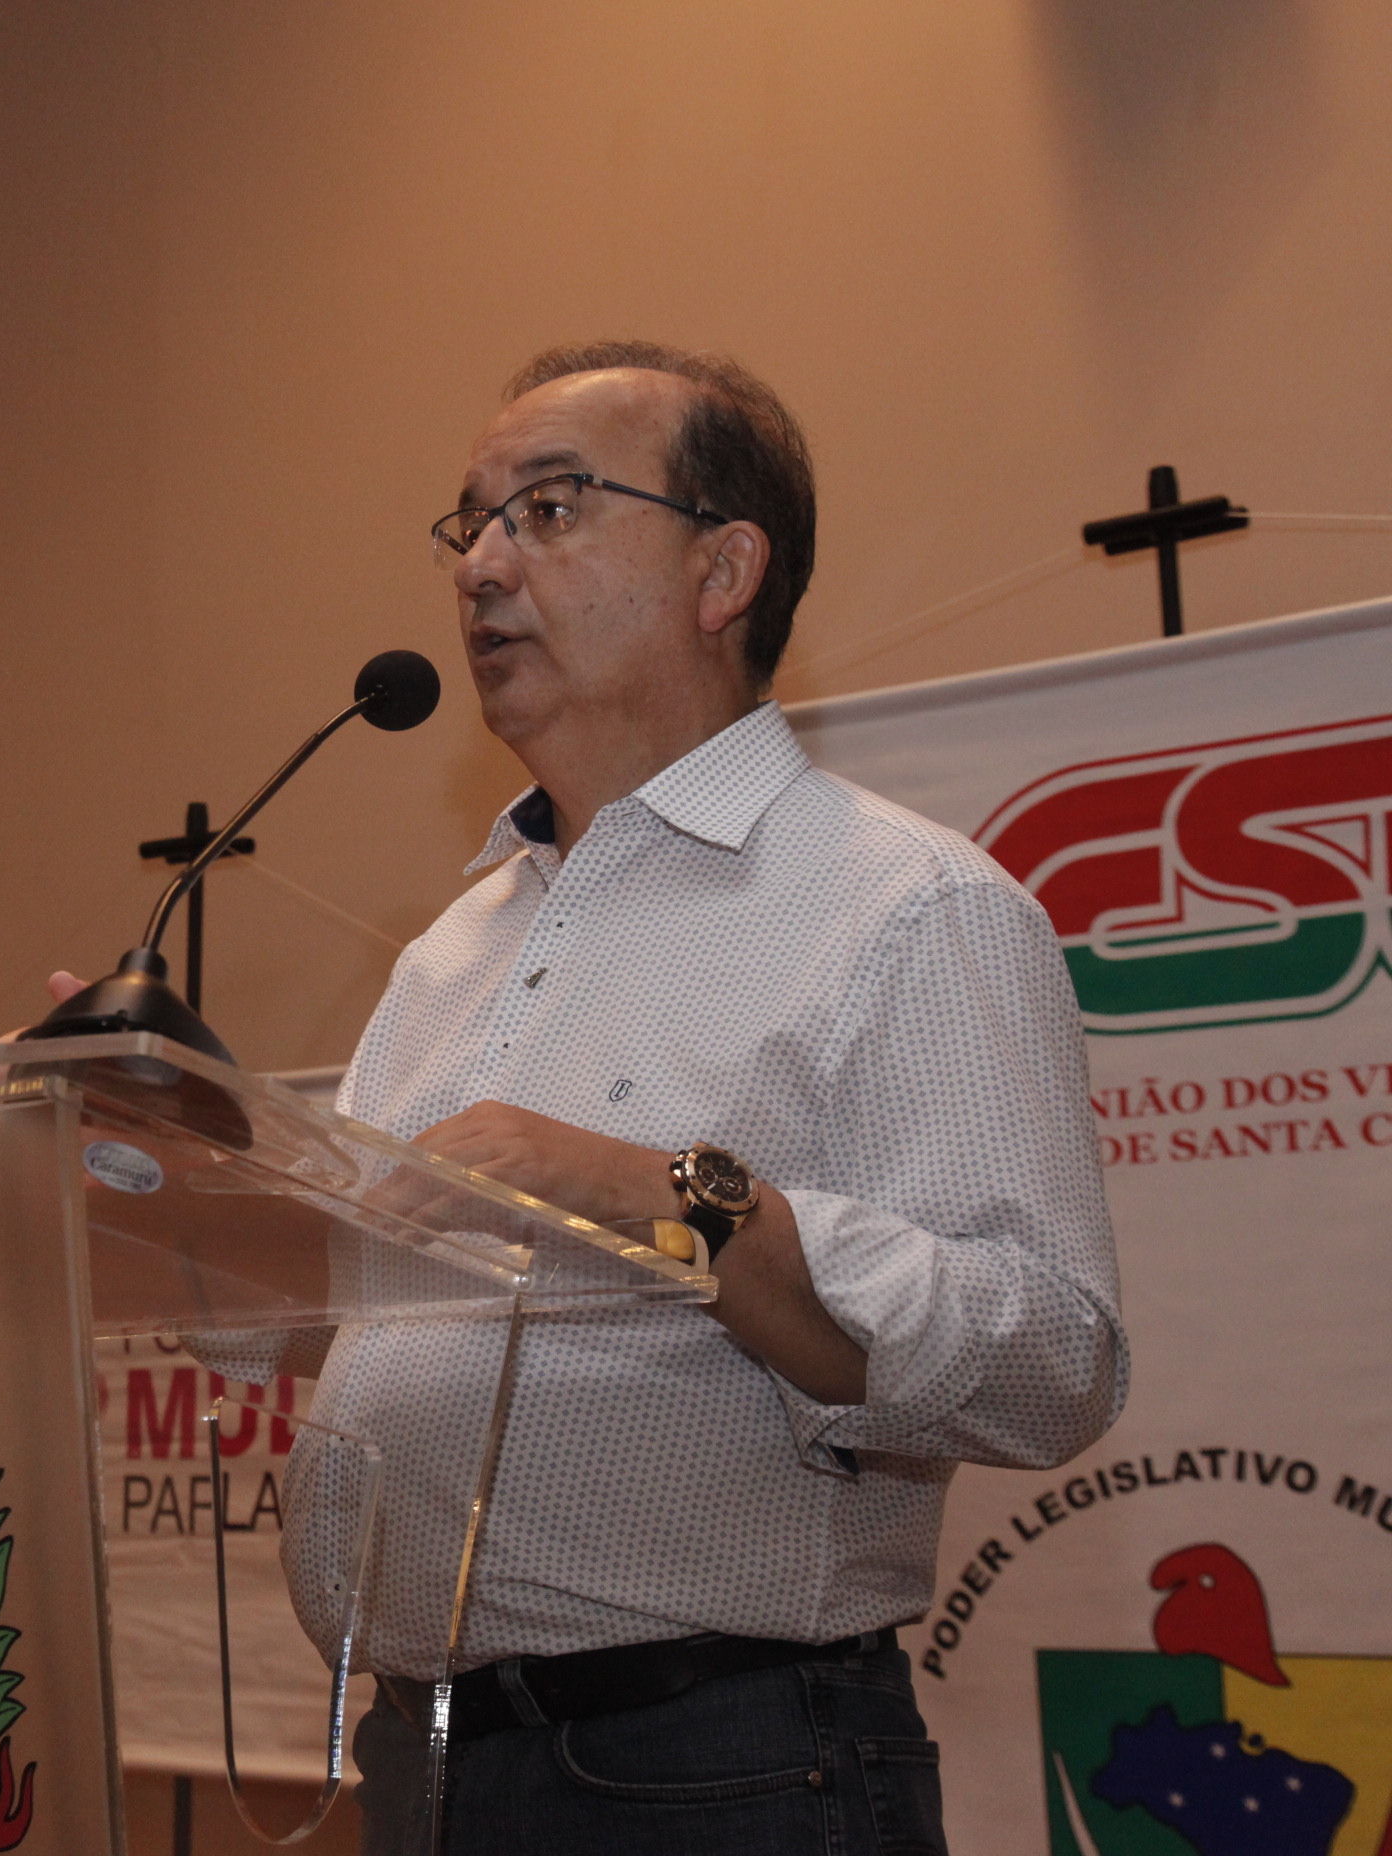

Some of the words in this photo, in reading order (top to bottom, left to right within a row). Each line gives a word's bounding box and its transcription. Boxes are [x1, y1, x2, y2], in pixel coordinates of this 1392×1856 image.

[1221, 1069, 1330, 1110] DOS
[1097, 1132, 1157, 1168] DE
[1169, 1117, 1347, 1161] SANTA
[921, 1537, 1015, 1682] PODER
[1011, 1447, 1318, 1544] LEGISLATIVO
